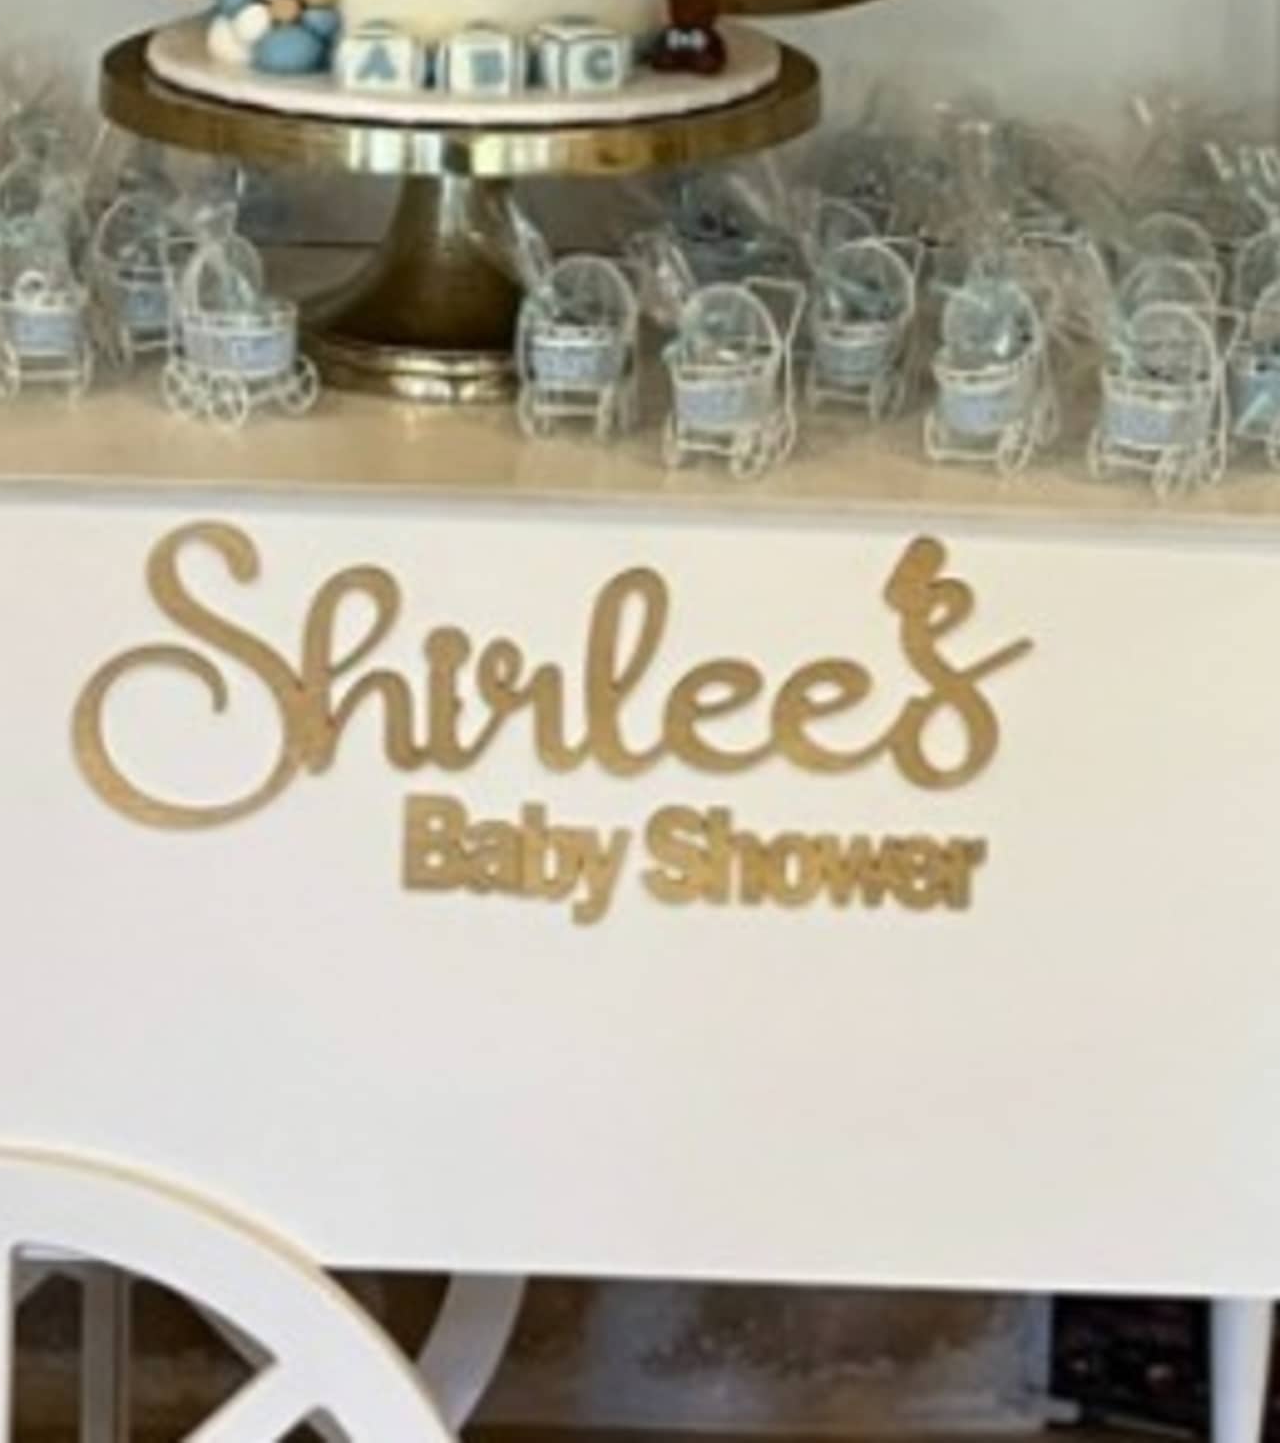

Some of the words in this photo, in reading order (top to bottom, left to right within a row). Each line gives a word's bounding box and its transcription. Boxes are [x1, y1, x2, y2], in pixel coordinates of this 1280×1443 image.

[355, 43, 399, 81] A
[583, 46, 615, 85] C
[71, 519, 1035, 832] Shirlee's
[401, 793, 631, 926] Baby
[641, 804, 988, 910] Shower
